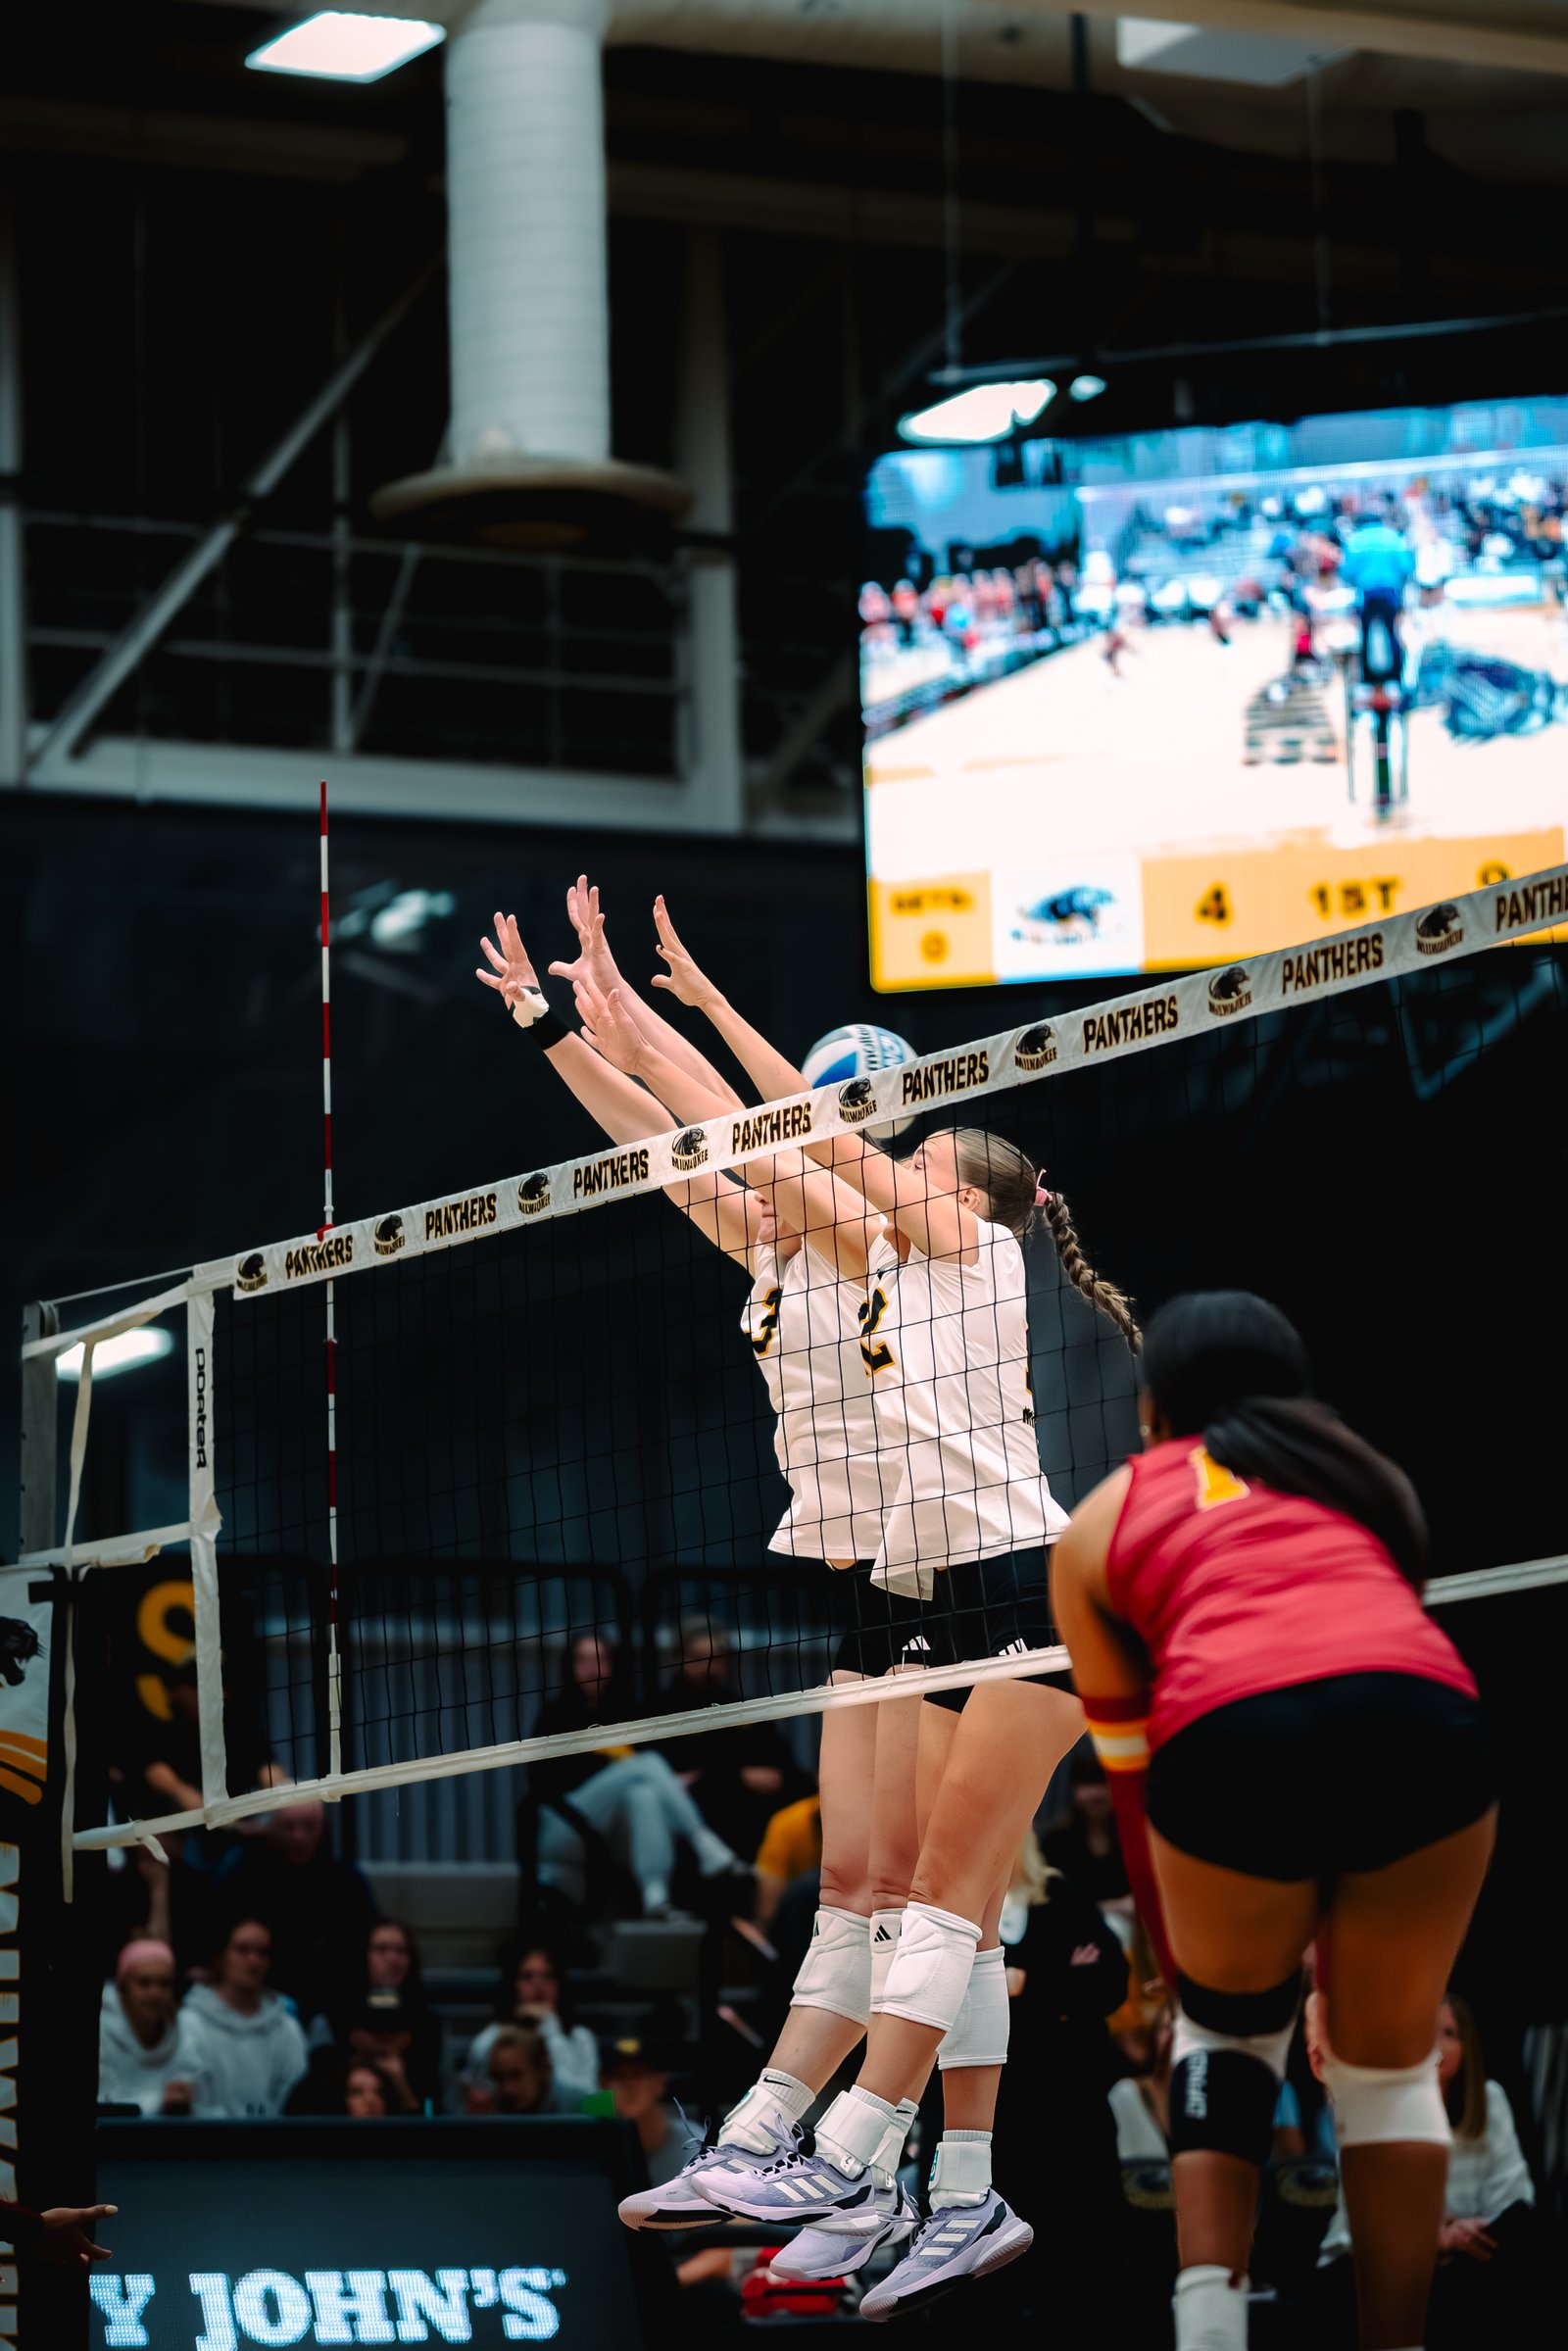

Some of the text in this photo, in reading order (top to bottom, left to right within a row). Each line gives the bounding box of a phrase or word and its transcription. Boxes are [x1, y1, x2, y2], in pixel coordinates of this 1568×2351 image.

[1196, 881, 1232, 926] 4
[1494, 874, 1568, 933] PANTH
[1281, 932, 1384, 995] PANTHERS
[1083, 995, 1178, 1053] PANTHERS
[902, 1051, 989, 1105] PANTHERS
[1014, 1048, 1057, 1071] MILWAUKEE
[731, 1102, 812, 1154] PANTHERS
[838, 1099, 878, 1124] MILWAUKEE
[573, 1149, 649, 1199] PANTHERS
[671, 1149, 709, 1172] MILWAUKEE
[425, 1192, 497, 1241] PANTHERS
[285, 1235, 353, 1280] PANTHERS
[188, 2268, 562, 2351] JOHN'S
